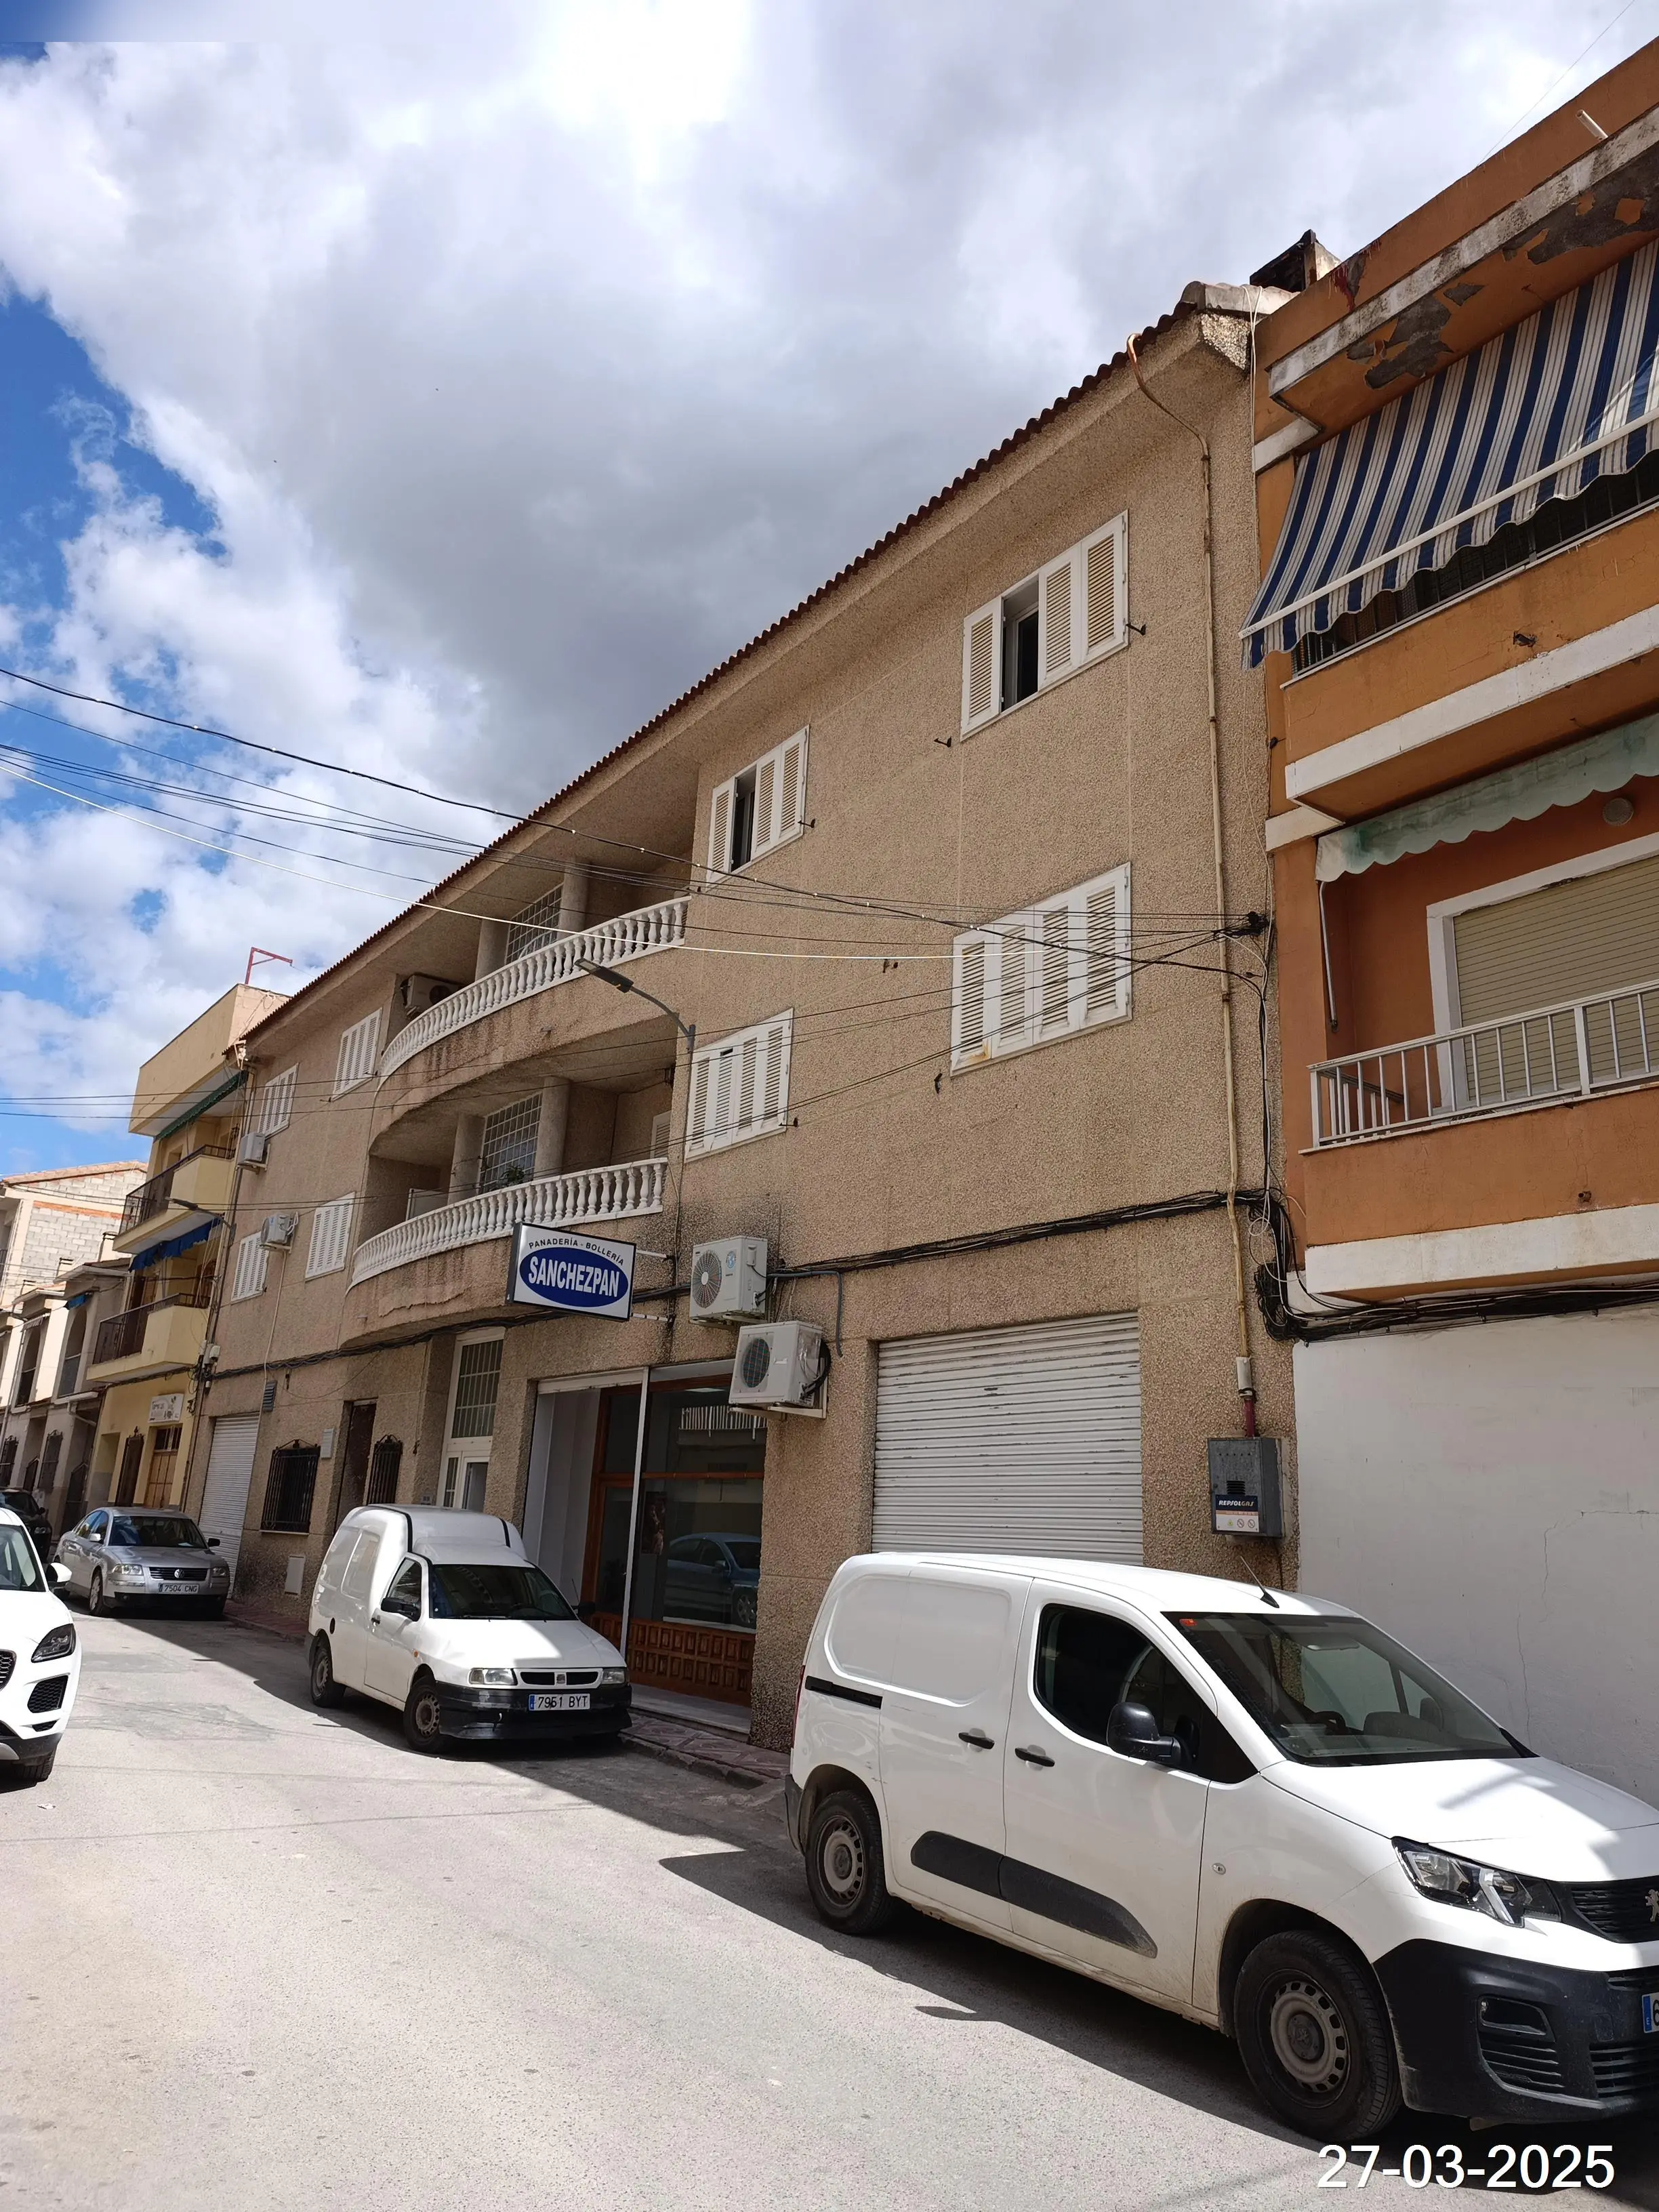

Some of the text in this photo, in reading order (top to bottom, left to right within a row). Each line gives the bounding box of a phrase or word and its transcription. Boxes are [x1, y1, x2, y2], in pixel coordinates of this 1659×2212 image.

[529, 1237, 578, 1249] PANADERÍA
[586, 1242, 623, 1266] BOLLERÍA
[528, 1256, 619, 1297] SANCHEZPAN
[569, 1696, 588, 1708] BYT
